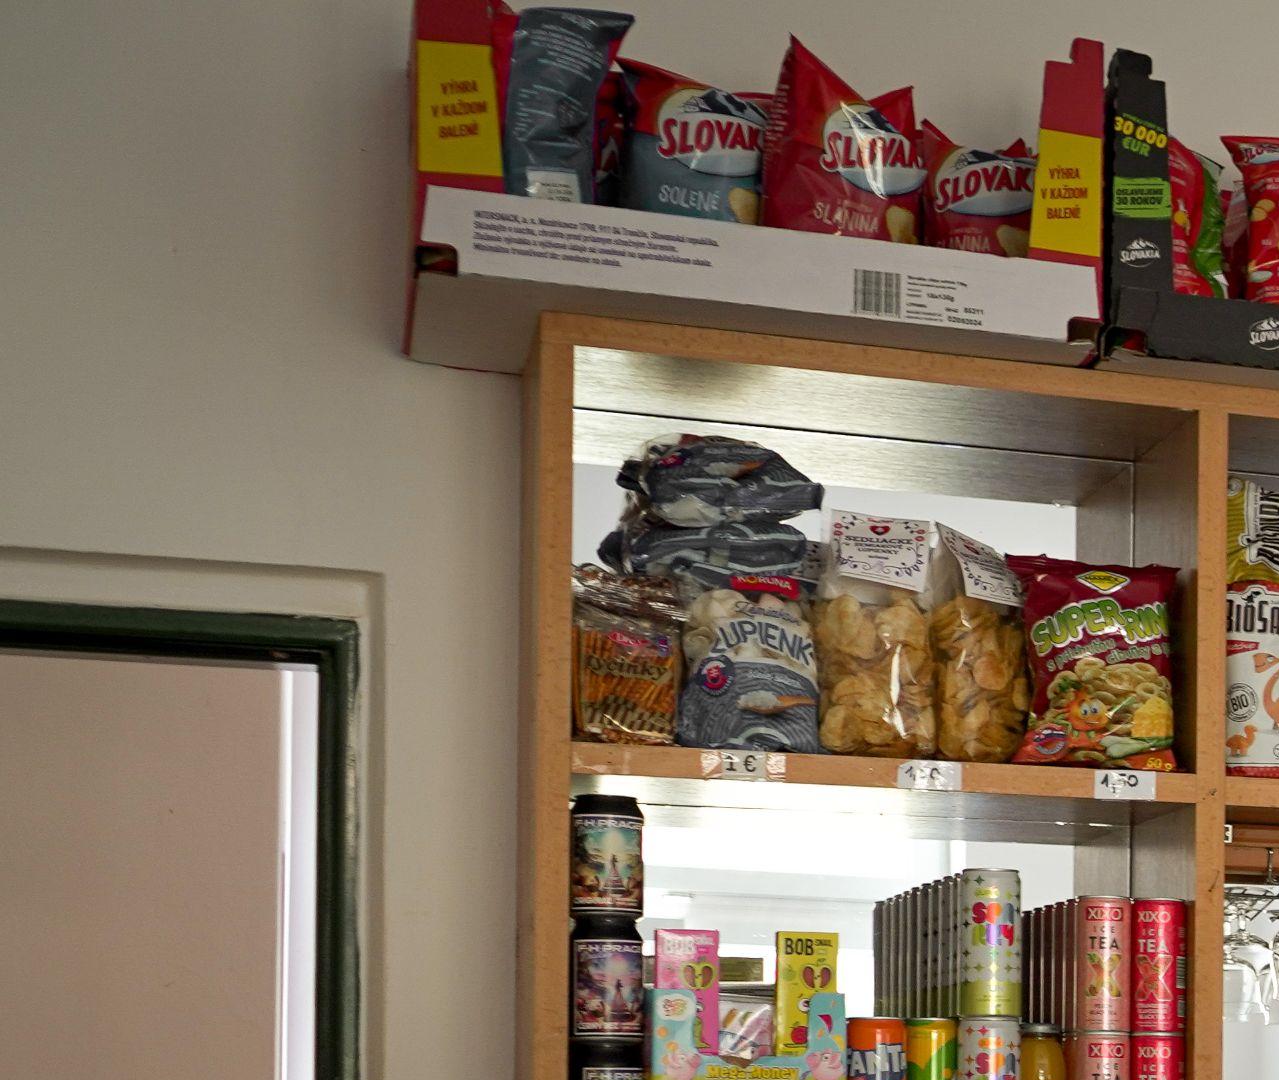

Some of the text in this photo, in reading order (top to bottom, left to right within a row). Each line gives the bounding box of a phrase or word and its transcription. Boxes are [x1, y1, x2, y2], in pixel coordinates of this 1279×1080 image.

[657, 117, 765, 158] SLOVAK
[1114, 115, 1132, 137] 30
[1135, 121, 1168, 149] 000
[820, 131, 924, 172] SLOVAK
[935, 164, 1034, 212] SLOVAK
[659, 183, 721, 211] SOLENÉ
[1120, 249, 1161, 263] SLOVAKIA
[1030, 597, 1170, 656] SUPER RIN
[1229, 694, 1250, 711] BIO
[743, 755, 758, 773] €
[1087, 906, 1121, 921] XIXO
[1137, 910, 1172, 924] XIXO
[784, 937, 815, 956] BOB
[1089, 936, 1120, 950] TEA
[1137, 939, 1170, 954] TEA
[1089, 1043, 1124, 1058] XIXO
[1137, 1046, 1172, 1059] XIXO
[706, 1065, 743, 1080] Mega
